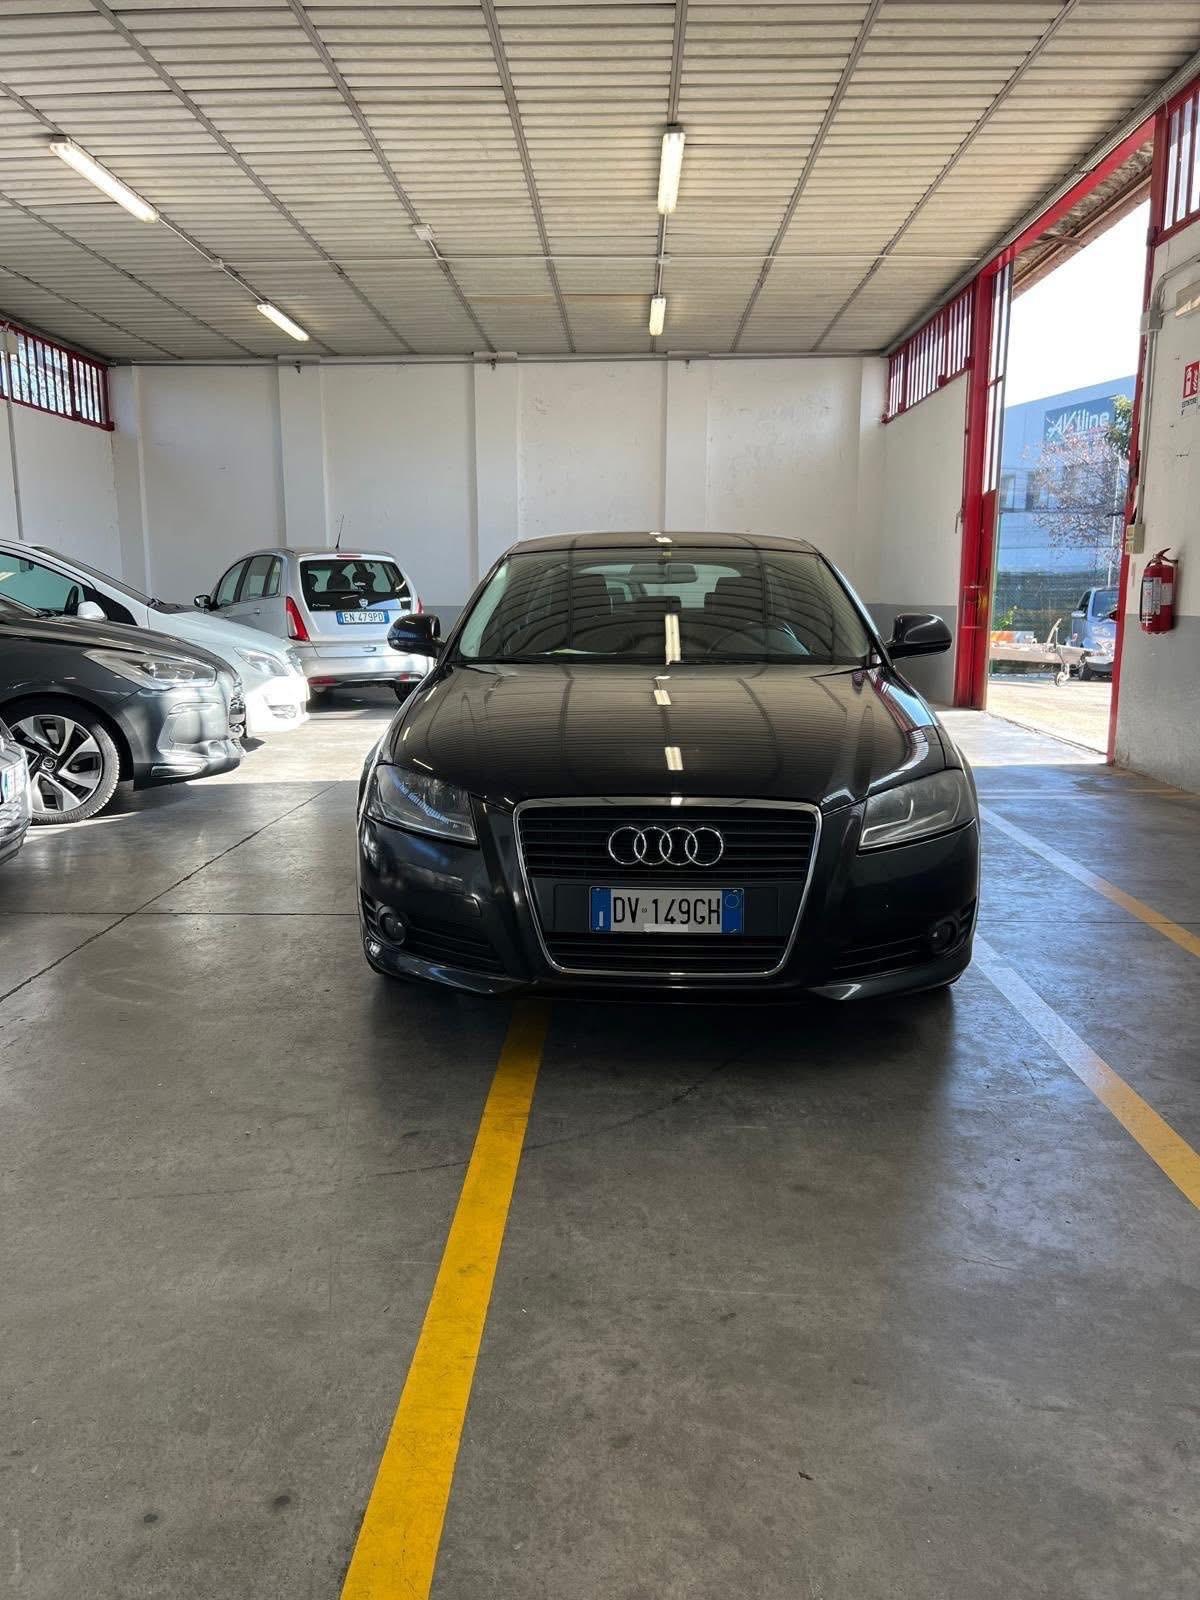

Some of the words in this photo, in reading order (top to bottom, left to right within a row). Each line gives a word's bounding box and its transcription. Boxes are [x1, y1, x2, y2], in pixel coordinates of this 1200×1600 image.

[344, 612, 355, 623] EN
[613, 897, 640, 924] DV
[652, 898, 720, 925] 149GH
